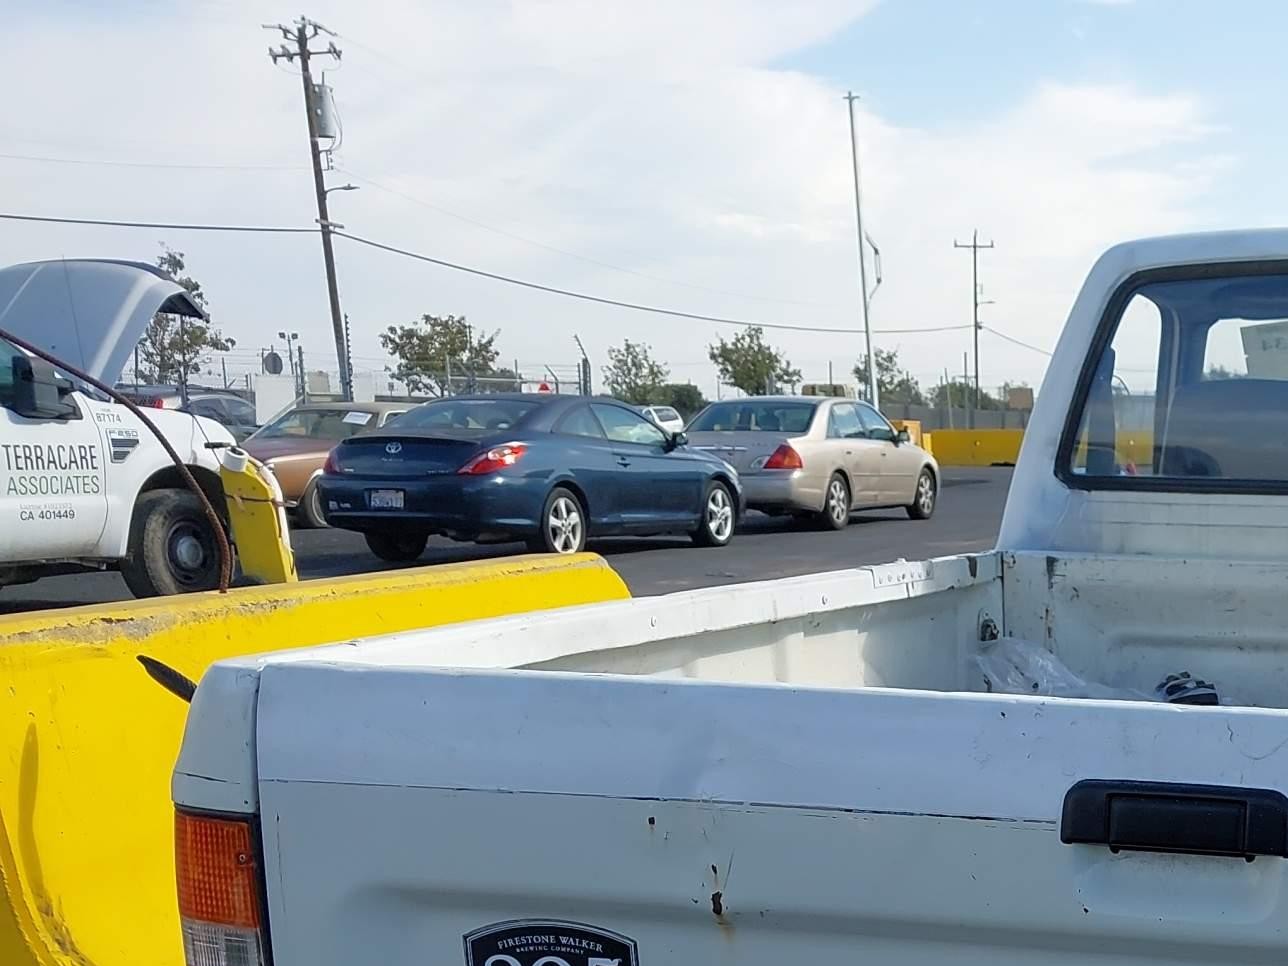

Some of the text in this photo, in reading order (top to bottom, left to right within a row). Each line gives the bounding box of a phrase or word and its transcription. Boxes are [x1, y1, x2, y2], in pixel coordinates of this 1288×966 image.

[2, 444, 99, 470] TERRACARE
[7, 475, 100, 496] ASSOCIATES
[20, 509, 75, 521] CA 401449
[497, 935, 604, 953] FIRESTONE WALKER
[516, 945, 585, 955] BREWING COMPANY
